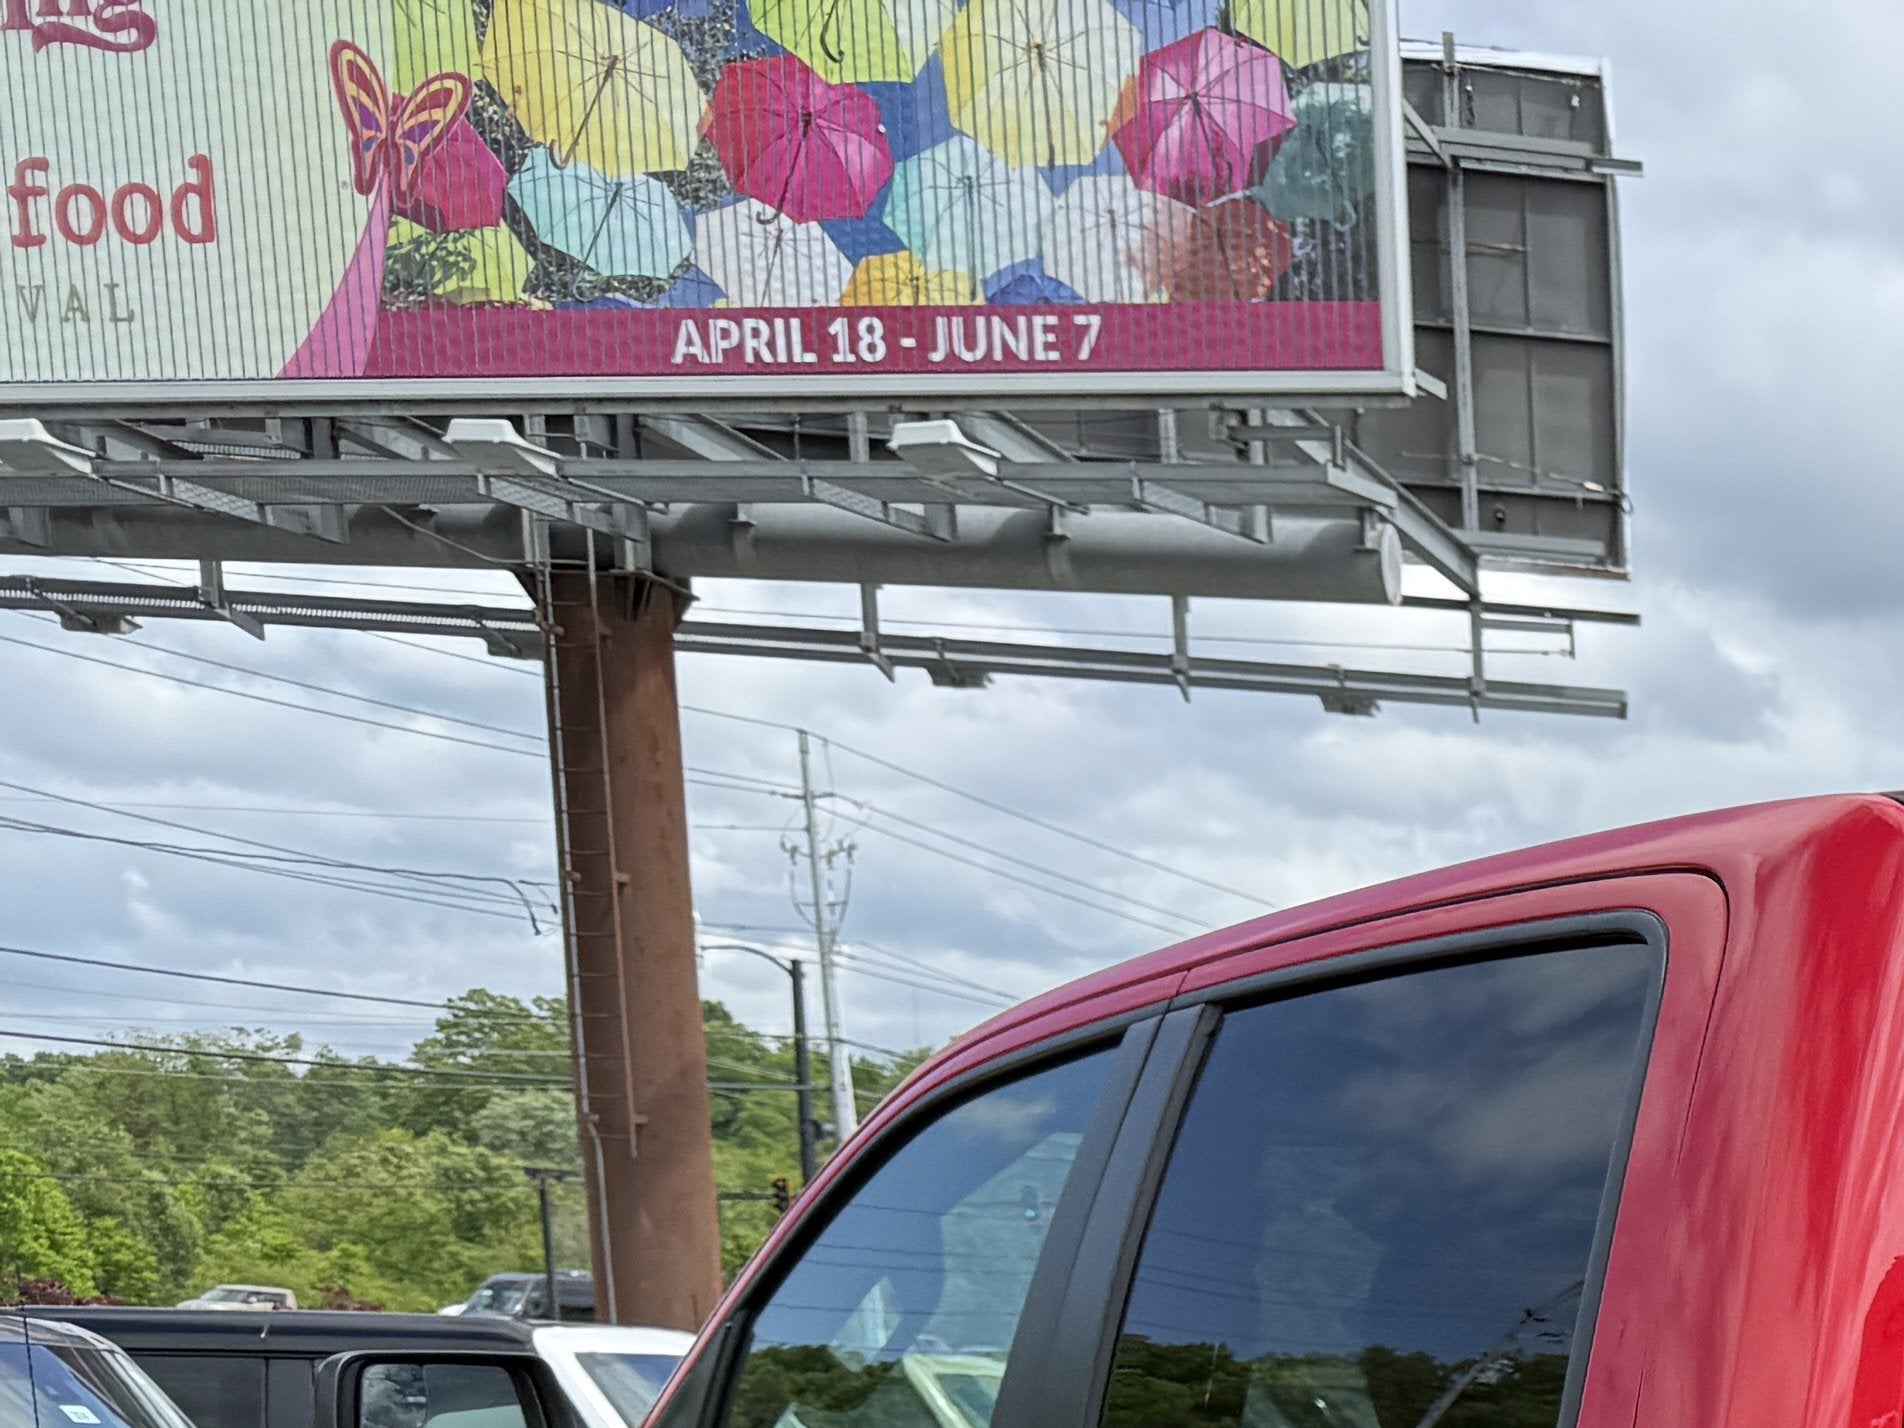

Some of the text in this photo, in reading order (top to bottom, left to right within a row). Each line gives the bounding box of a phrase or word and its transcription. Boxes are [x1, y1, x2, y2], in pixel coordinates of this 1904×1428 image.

[8, 154, 215, 247] food
[17, 283, 135, 324] VAL
[671, 317, 818, 364] APRIL
[828, 316, 887, 363] 18
[928, 315, 1061, 363] JUNE
[1072, 314, 1101, 361] 7
